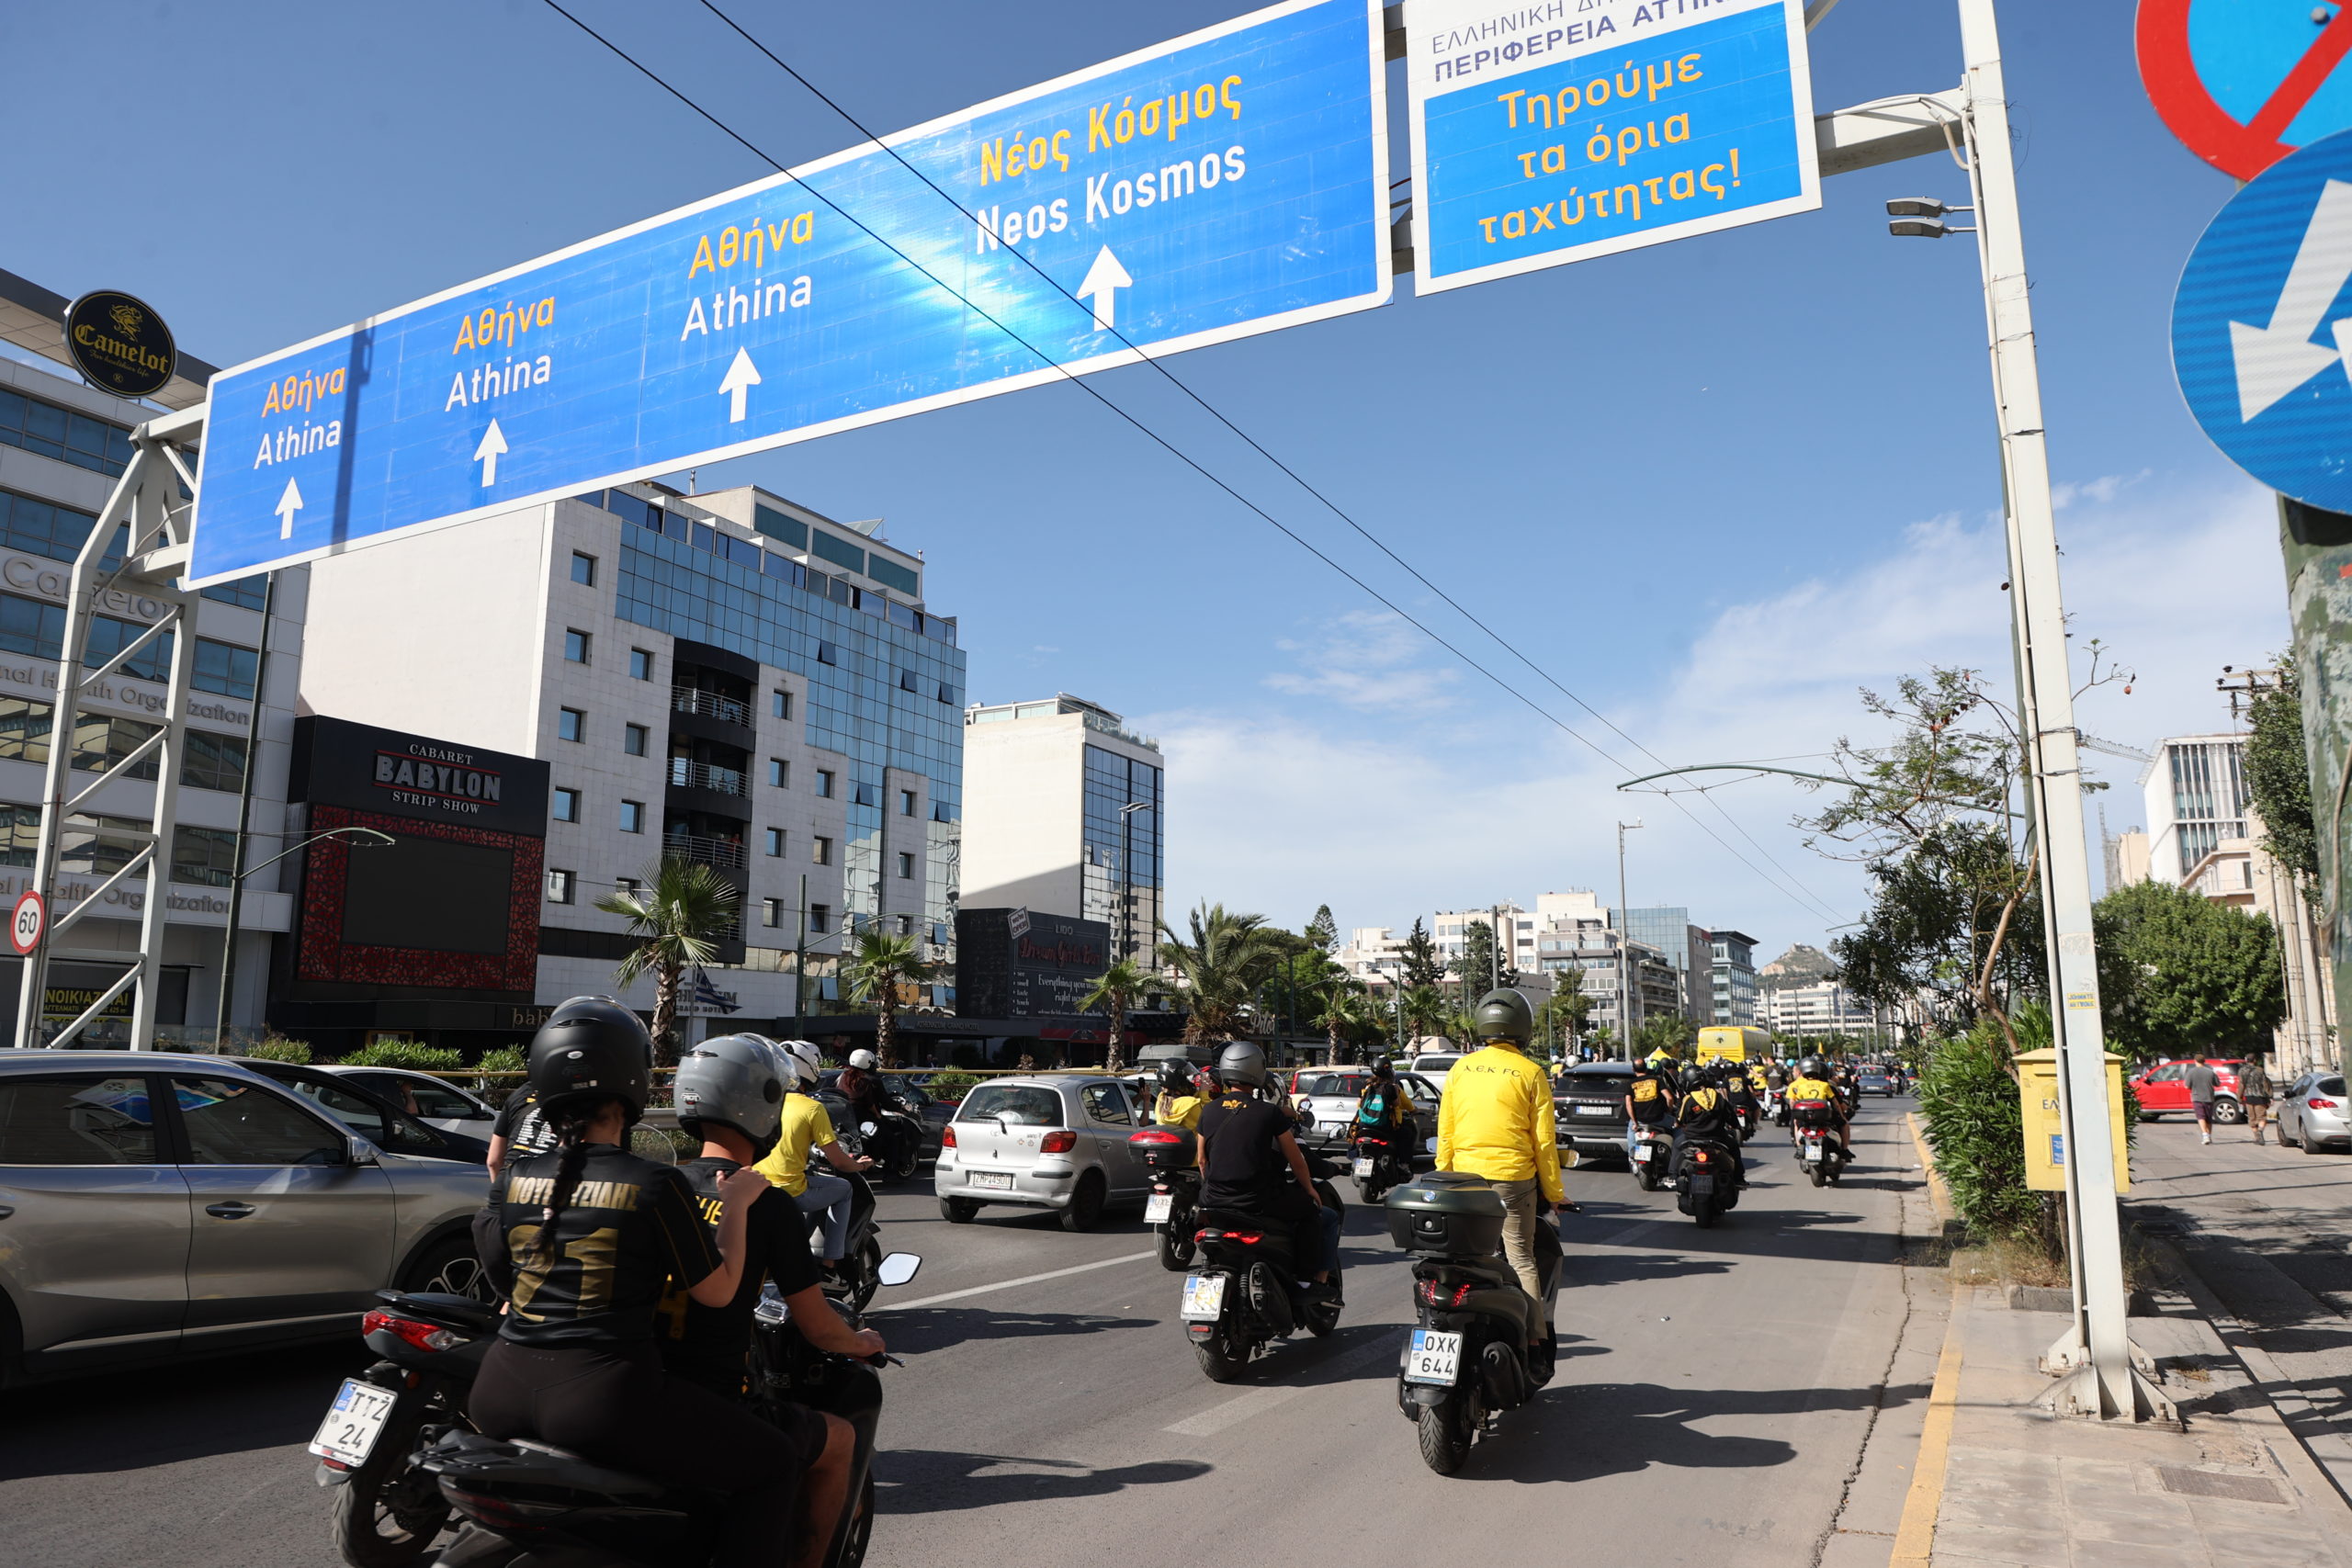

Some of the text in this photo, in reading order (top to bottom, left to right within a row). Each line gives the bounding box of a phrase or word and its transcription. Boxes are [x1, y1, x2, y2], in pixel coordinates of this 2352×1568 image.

[1434, 16, 1617, 82] ΠΕΡΙΦΕΡΕΙΑ
[1497, 53, 1703, 129] Τηρούμε
[979, 74, 1242, 187] Νέος Κόσμος
[1517, 112, 1690, 178] τα όρια
[976, 145, 1246, 255] Neos Kosmos
[1478, 148, 1741, 243] ταχύτητας!
[687, 209, 814, 279] Αθήνα
[453, 295, 555, 356] Αθήνα
[680, 275, 813, 342] Athina
[74, 323, 169, 374] Camelot
[261, 367, 346, 418] Αθήνα
[444, 354, 552, 412] Athina
[253, 419, 343, 470] Athina
[375, 755, 501, 801] BABYLON
[409, 743, 473, 765] CABARET
[392, 790, 480, 814] STRIP SHOW
[18, 910, 38, 935] 60
[1502, 1068, 1521, 1077] FC
[508, 1224, 618, 1322] 21
[1421, 1357, 1453, 1376] 644
[1425, 1336, 1458, 1354] OXK
[338, 1424, 366, 1449] 24
